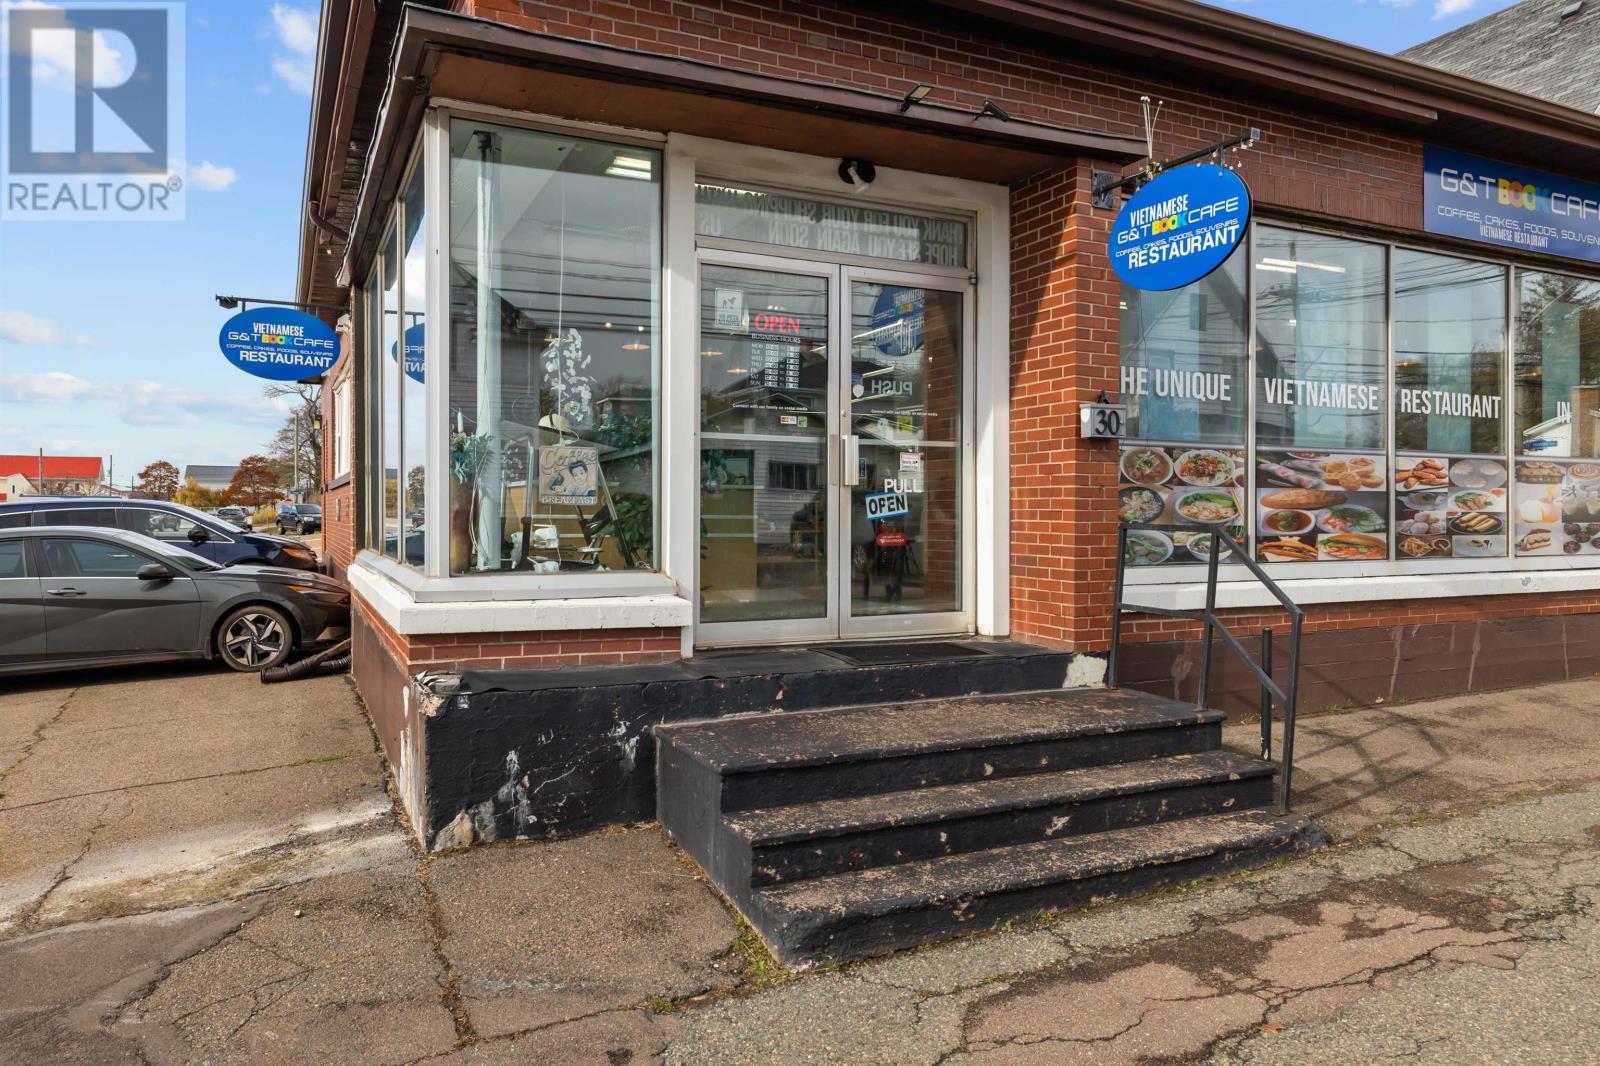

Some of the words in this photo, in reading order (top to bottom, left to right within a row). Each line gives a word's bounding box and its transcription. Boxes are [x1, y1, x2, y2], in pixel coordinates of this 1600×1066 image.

[1440, 167, 1496, 200] G&T
[1497, 178, 1550, 214] BOOK
[1117, 223, 1151, 245] G&T
[1151, 212, 1188, 236] BOOK
[1188, 196, 1239, 224] CAFE
[1130, 194, 1189, 228] VIETNAMESE
[1437, 205, 1482, 224] COFFEE,
[1484, 214, 1522, 232] CAKES,
[1523, 222, 1559, 239] FOODS,
[1128, 224, 1240, 270] RESTAURANT
[1479, 224, 1513, 243] VIETNAMESE
[1513, 231, 1549, 249] RESTAURANT
[253, 322, 304, 337] VIETNAMESE
[753, 311, 801, 336] OPEN
[228, 331, 261, 342] G&T
[261, 334, 294, 345] BOOK
[294, 337, 334, 349] CAFE
[239, 350, 333, 367] RESTAURANT
[1155, 368, 1232, 402] UNIQUE
[1264, 377, 1379, 412] VIETNAMESE
[1400, 388, 1501, 419] RESTAURANT
[1556, 401, 1570, 423] IN
[1095, 409, 1120, 435] 30
[884, 478, 924, 493] PULL
[541, 496, 596, 505] BREAKFAST
[868, 494, 906, 515] OPEN
